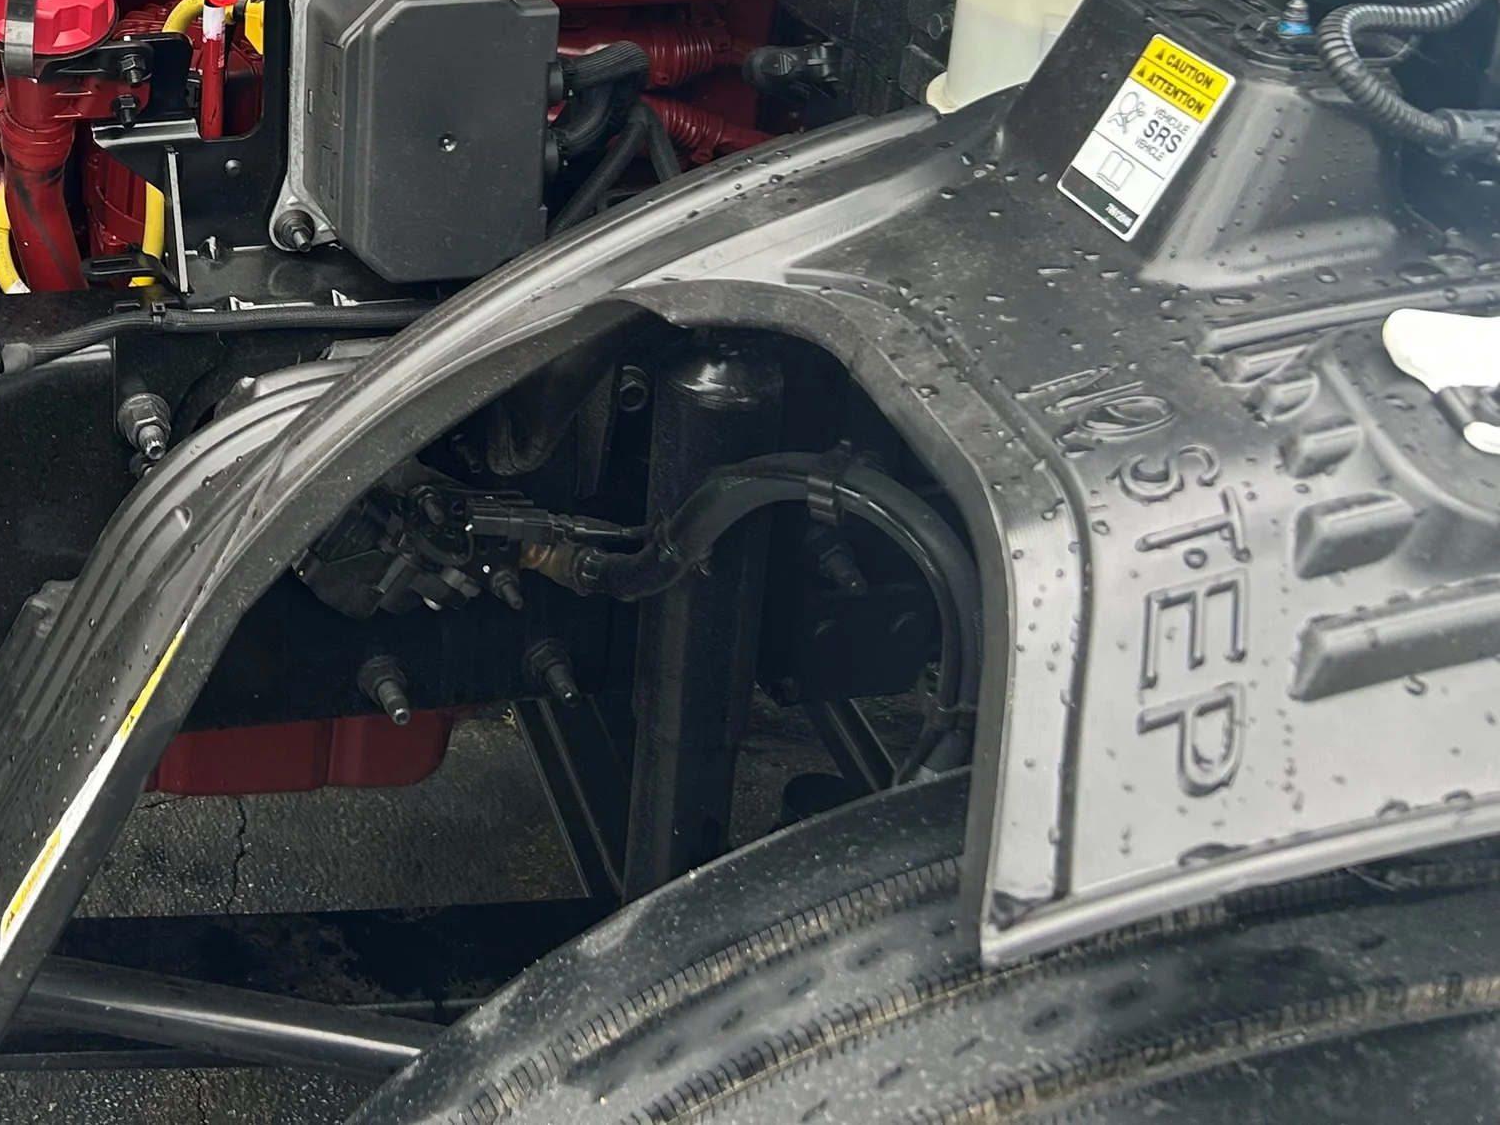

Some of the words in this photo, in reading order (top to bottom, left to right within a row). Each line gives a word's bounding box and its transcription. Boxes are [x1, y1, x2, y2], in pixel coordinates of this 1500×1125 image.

[1166, 53, 1214, 89] CAUTION
[1146, 71, 1206, 115] ATTENTION
[1143, 119, 1183, 154] SRS
[1153, 106, 1192, 136] VÉHICULE
[1135, 137, 1166, 162] VEHICLE
[1013, 364, 1177, 442] NO
[1106, 443, 1252, 798] STEP
